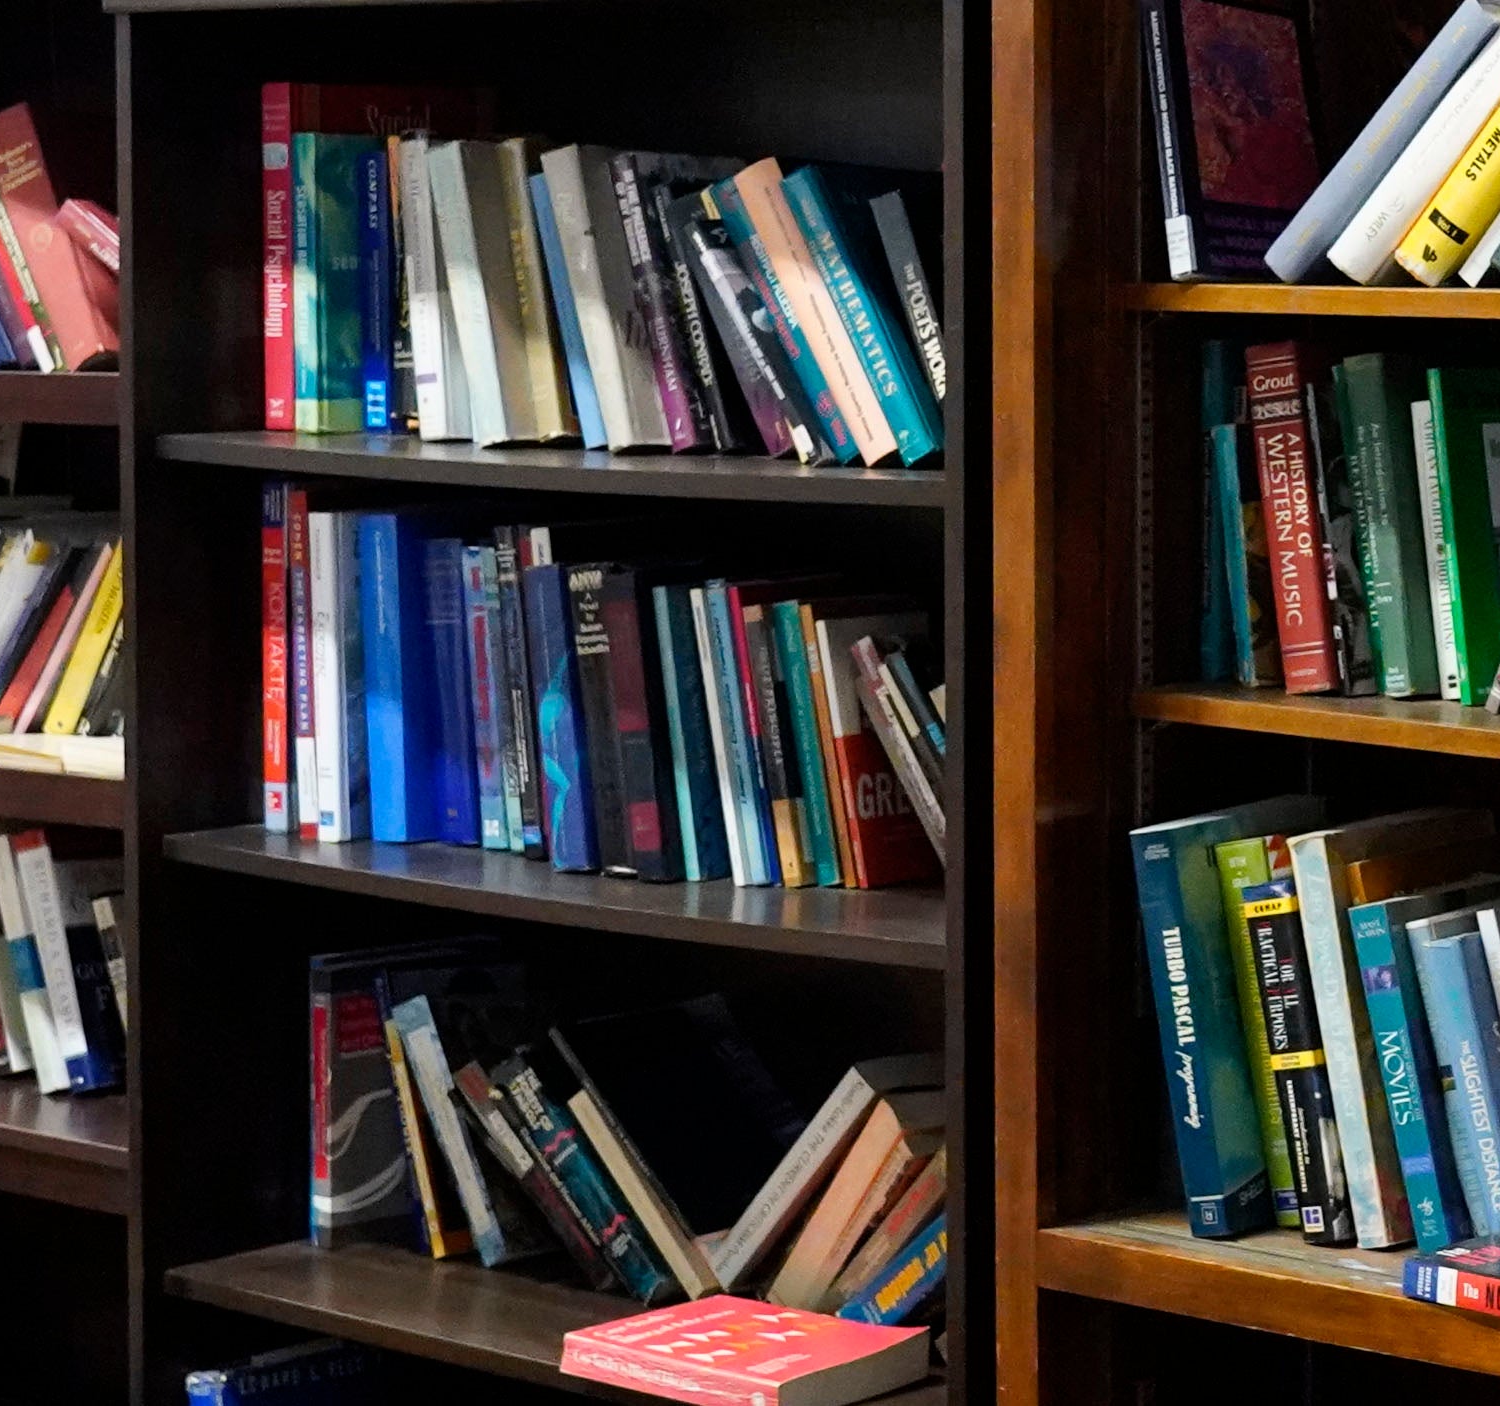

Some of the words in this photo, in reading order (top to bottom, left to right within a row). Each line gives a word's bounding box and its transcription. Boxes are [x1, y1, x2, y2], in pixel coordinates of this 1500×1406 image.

[265, 190, 285, 238] Social
[262, 245, 287, 336] Psychology
[671, 260, 699, 319] JOSEPH
[813, 230, 901, 398] MATHEMATICS
[904, 279, 937, 339] POET'S
[1253, 373, 1293, 392] Grout
[1286, 432, 1301, 446] A
[1266, 434, 1293, 542] WESTERN
[1288, 450, 1308, 525] HISTORY
[1296, 531, 1311, 557] OF
[1278, 549, 1303, 627] MUSIC
[1162, 926, 1186, 982] TURBO
[1170, 984, 1195, 1045] PASCAL
[1174, 1049, 1204, 1129] programming
[1378, 1028, 1414, 1126] MOVIES
[1459, 1053, 1491, 1133] SLIGHTEST
[1463, 1282, 1479, 1299] The
